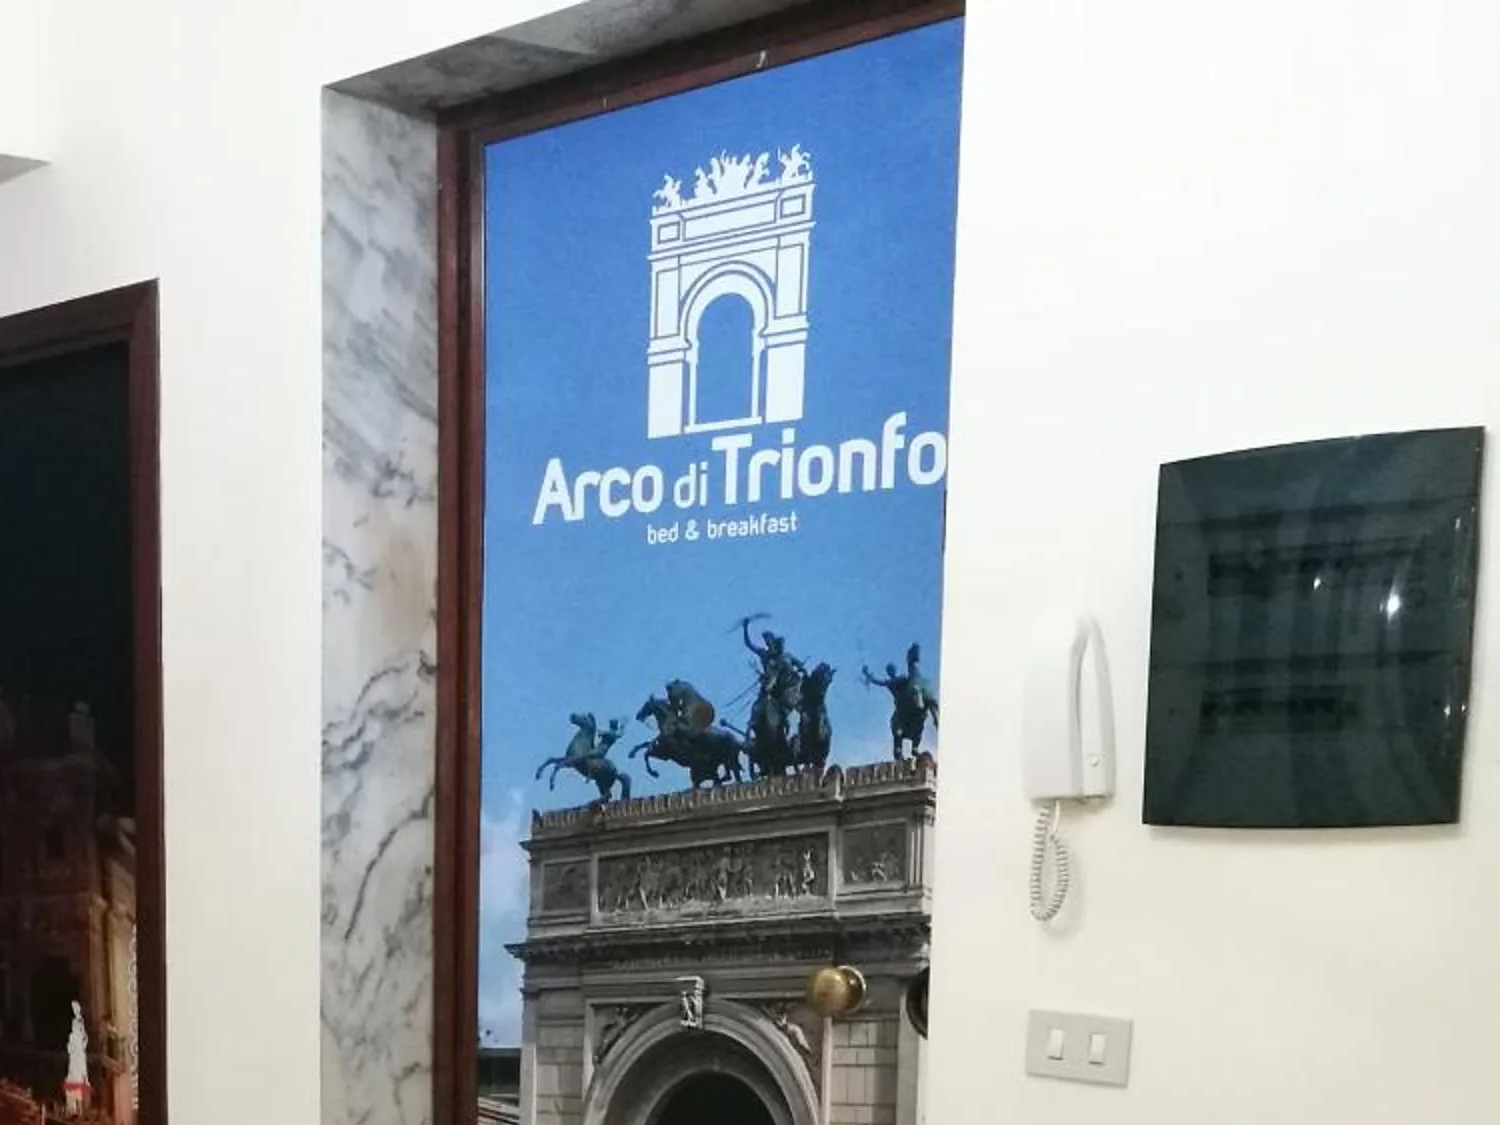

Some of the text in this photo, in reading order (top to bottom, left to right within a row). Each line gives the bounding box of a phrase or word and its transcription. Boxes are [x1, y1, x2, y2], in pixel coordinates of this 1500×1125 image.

[532, 411, 947, 525] Arco di Trionfo
[647, 511, 798, 545] bed & breakfast
